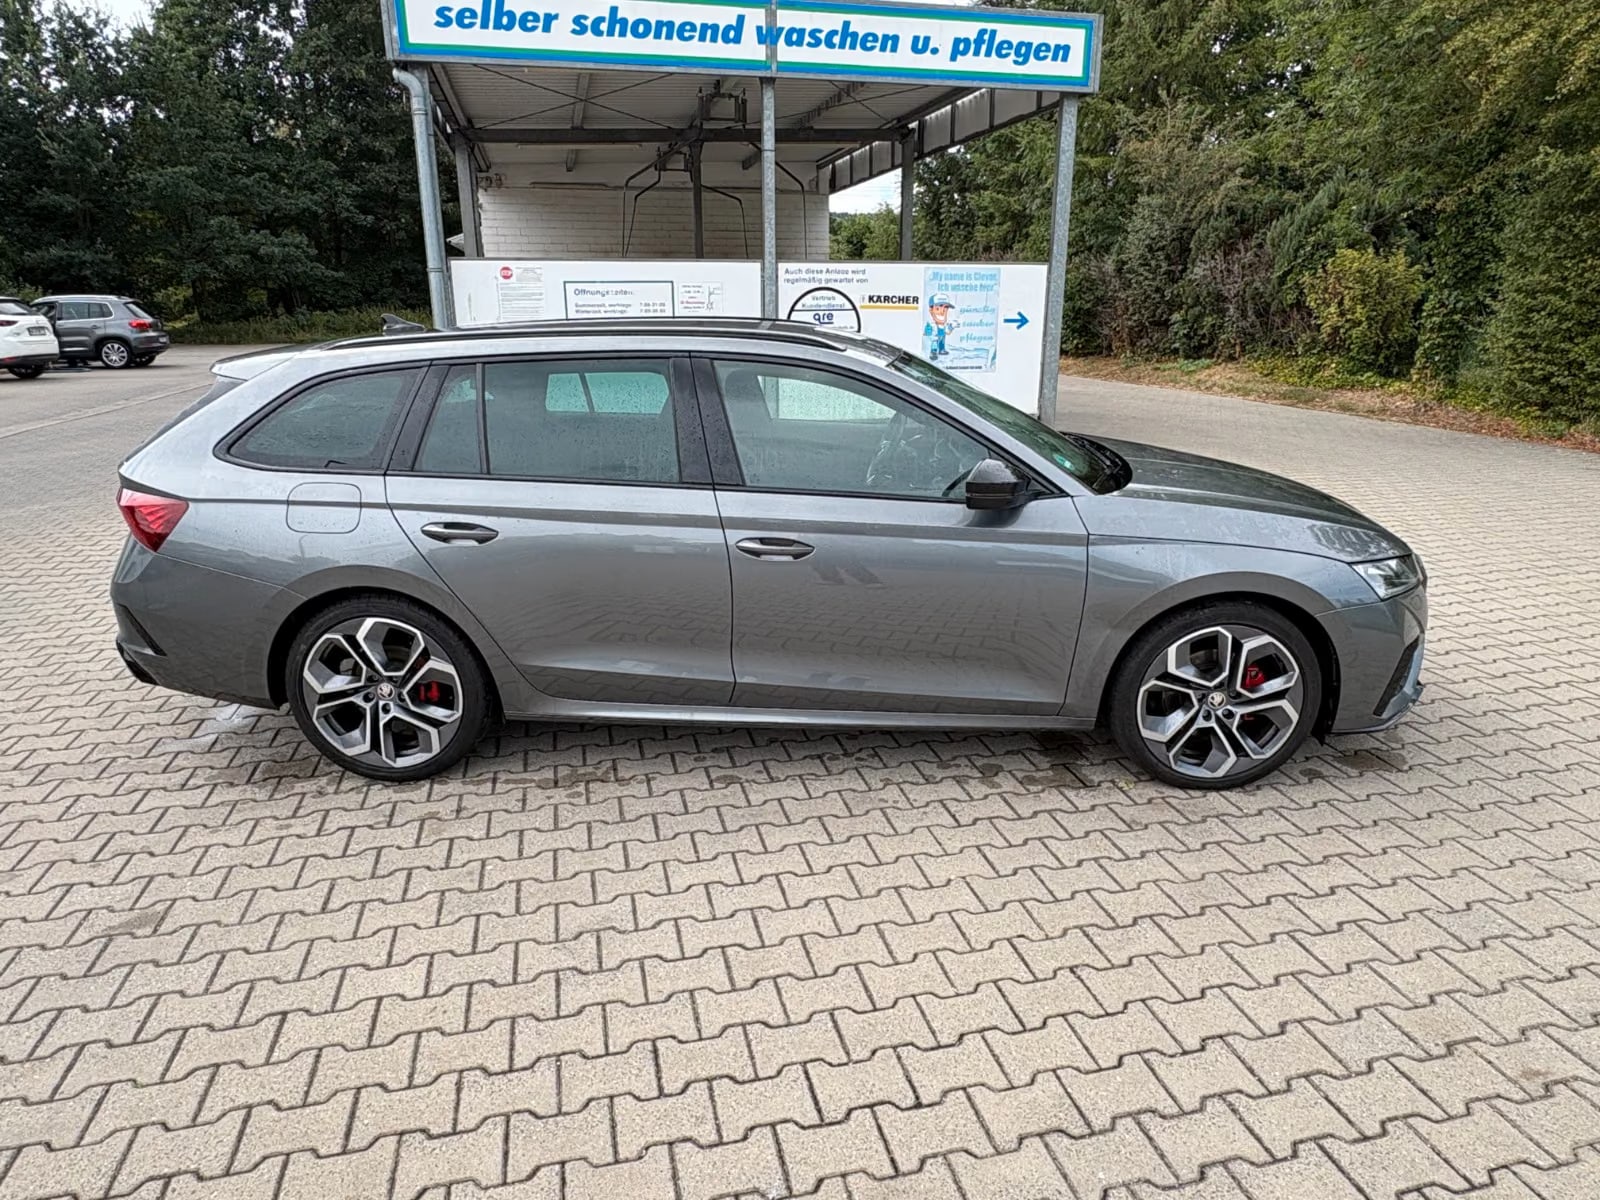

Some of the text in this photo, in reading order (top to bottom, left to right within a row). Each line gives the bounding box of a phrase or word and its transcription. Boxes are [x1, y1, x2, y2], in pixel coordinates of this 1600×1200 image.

[434, 0, 1071, 65] selber schonend waschen u. pflegen
